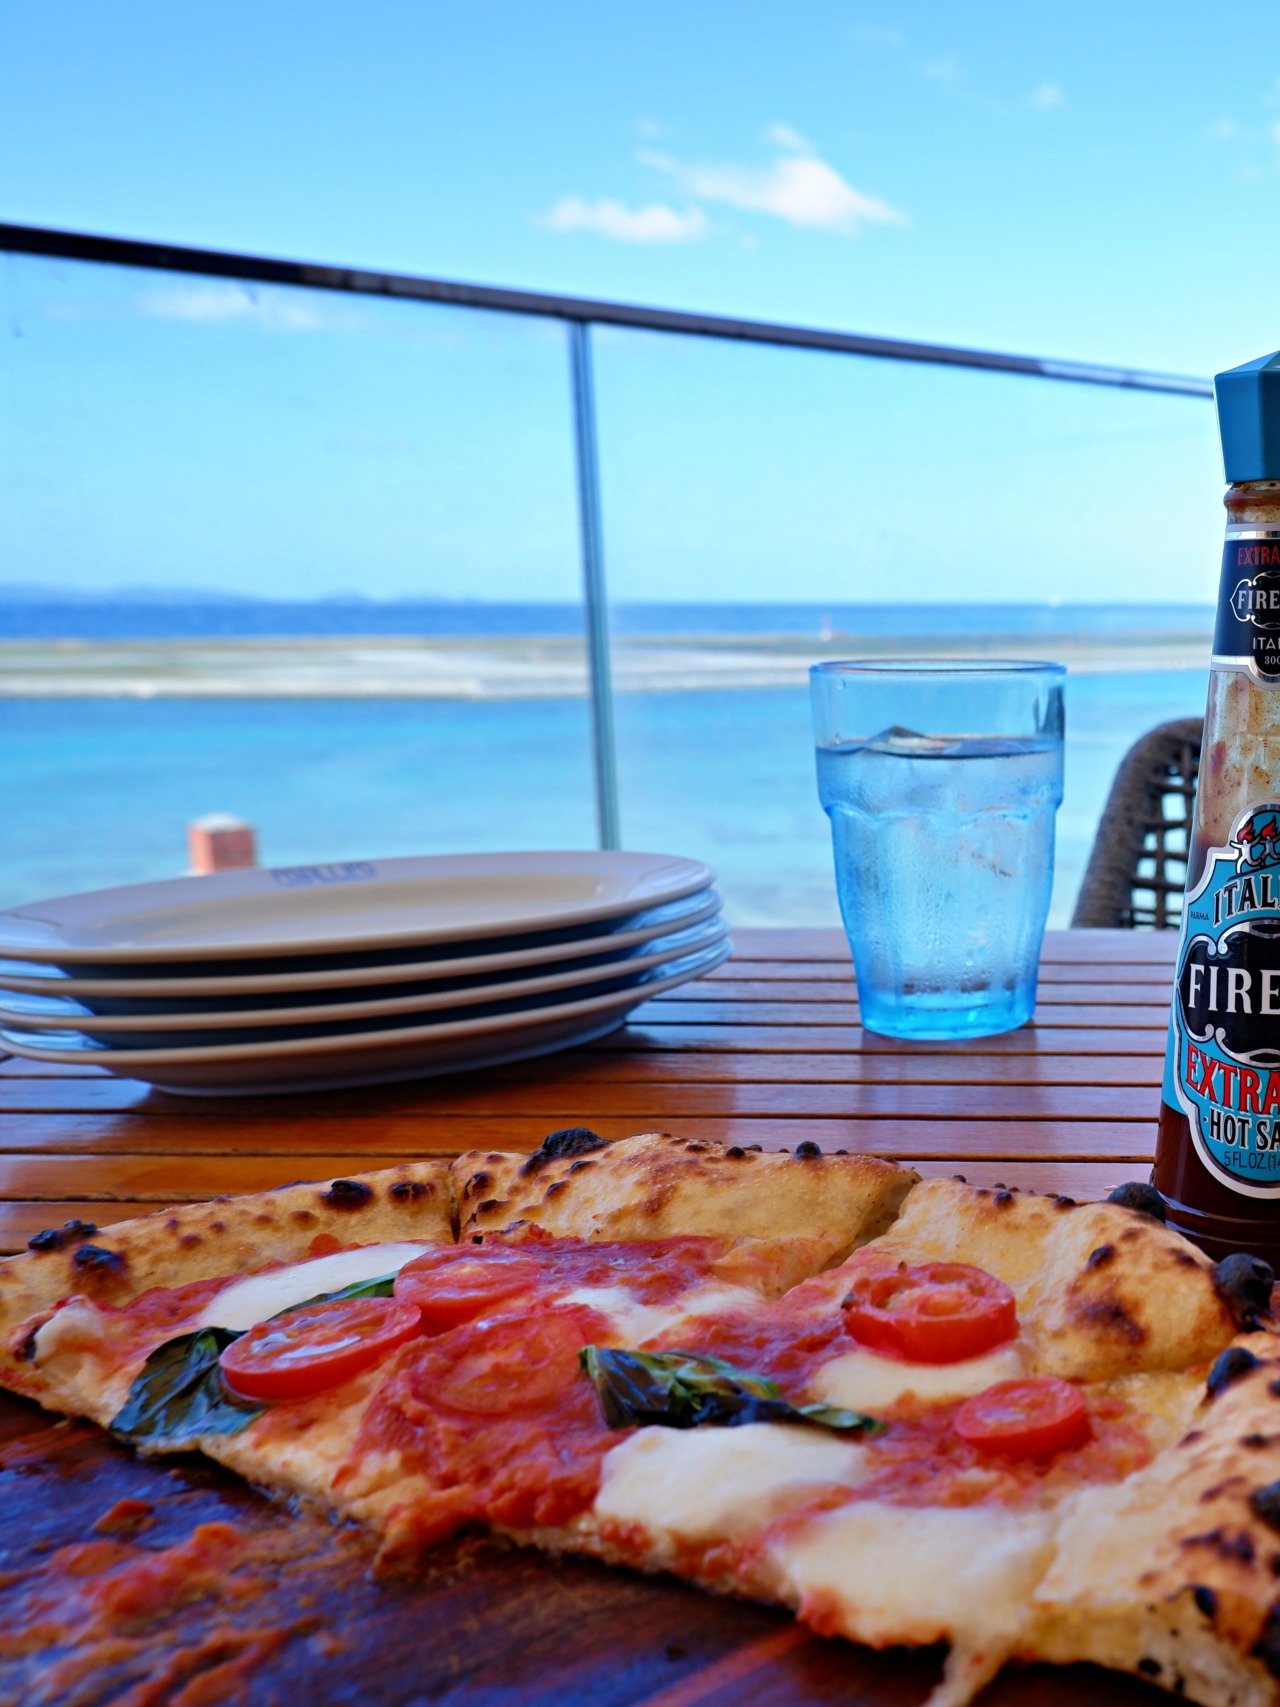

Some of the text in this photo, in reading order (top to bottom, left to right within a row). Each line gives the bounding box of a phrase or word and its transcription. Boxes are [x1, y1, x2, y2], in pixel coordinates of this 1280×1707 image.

[1237, 546, 1280, 565] EXTRA
[1190, 911, 1210, 921] PARMA
[1208, 1106, 1252, 1149] HOT
[1224, 1151, 1231, 1167] 5
